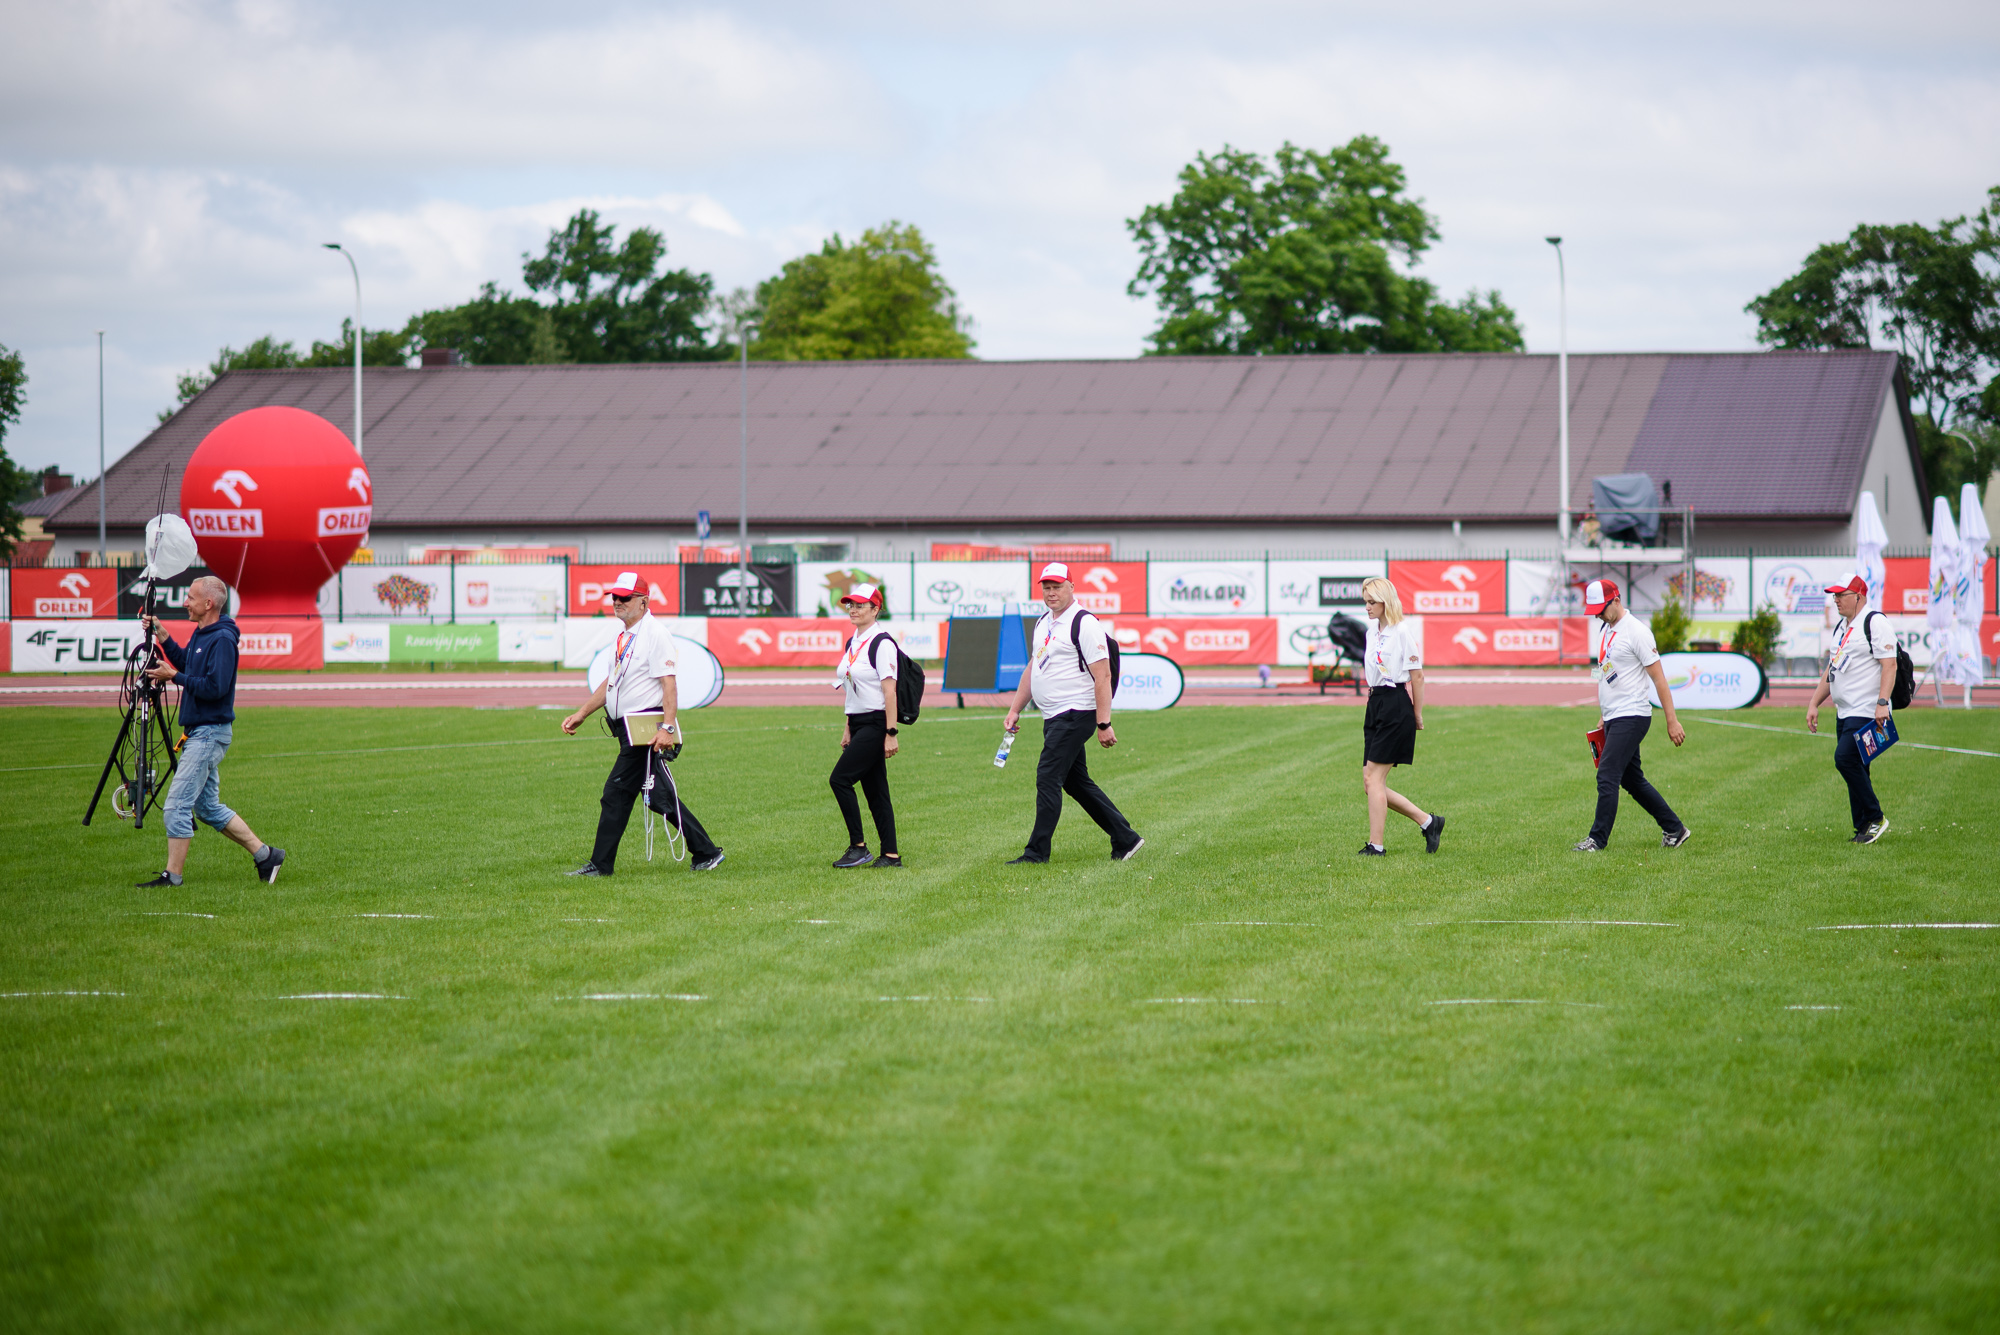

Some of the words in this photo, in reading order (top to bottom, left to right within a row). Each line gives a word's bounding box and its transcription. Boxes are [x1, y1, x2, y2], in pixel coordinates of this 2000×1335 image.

[194, 515, 256, 532] ORLEN
[324, 512, 370, 530] ORLEN
[39, 602, 89, 613] ORLEN
[1420, 596, 1474, 608] ORLEN
[958, 603, 988, 616] TYCZKA
[238, 638, 287, 649] ORLEN
[784, 636, 837, 647] ORLEN
[1190, 635, 1244, 647] ORLEN
[1499, 635, 1553, 646] ORLEN
[1120, 674, 1163, 688] OSIR
[1699, 672, 1741, 687] OSIR
